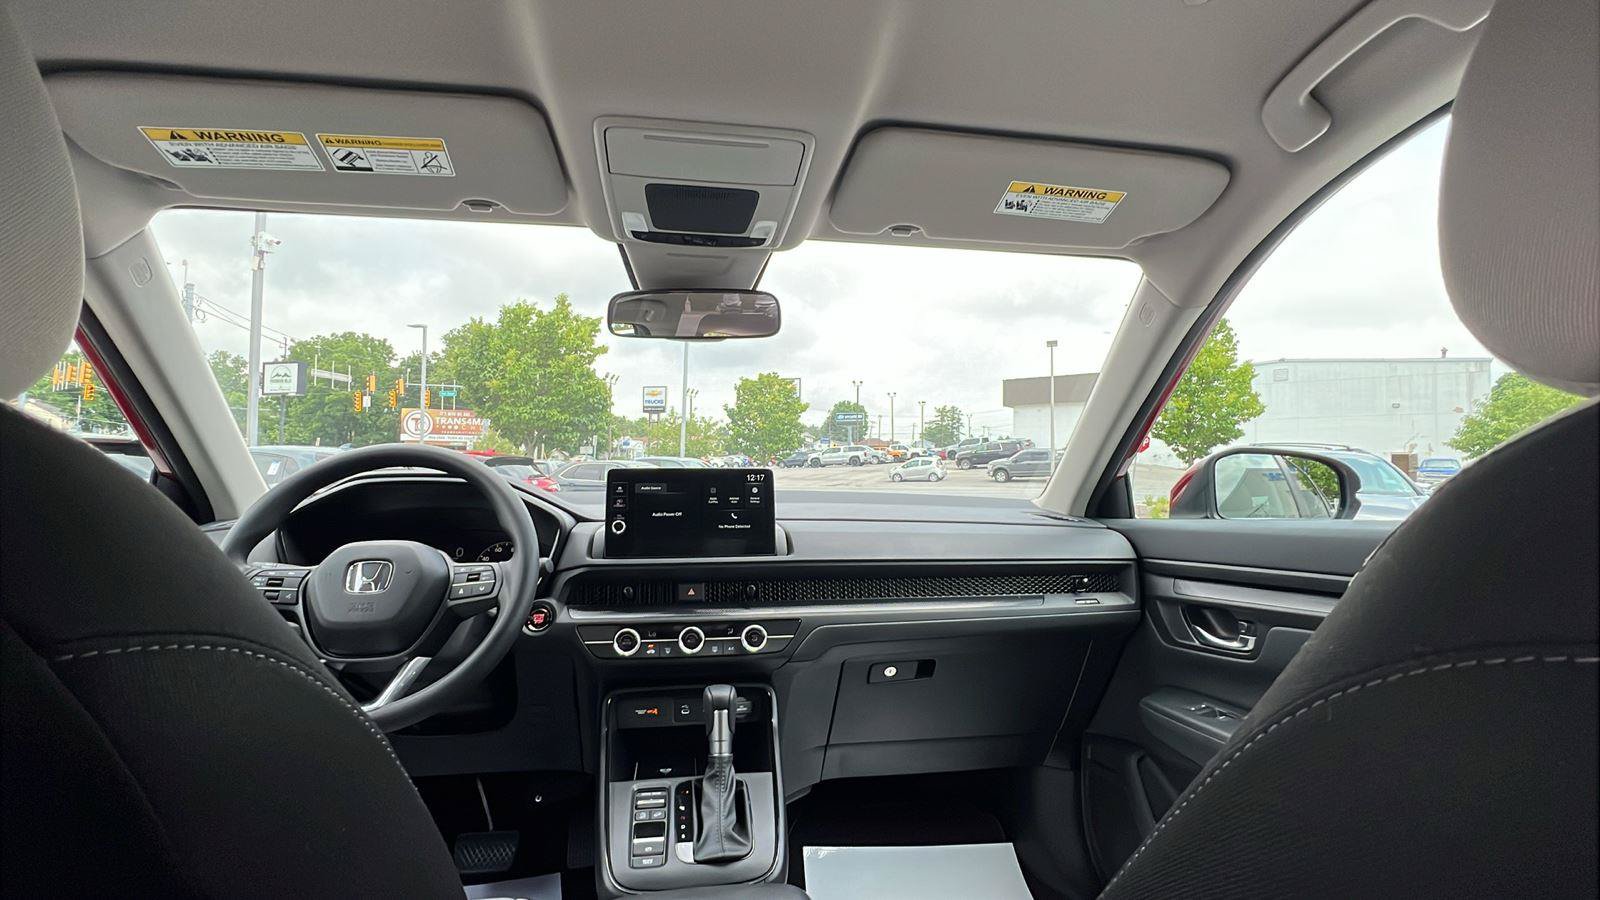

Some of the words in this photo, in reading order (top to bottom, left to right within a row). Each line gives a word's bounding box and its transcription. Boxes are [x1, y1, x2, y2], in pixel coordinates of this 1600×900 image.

[193, 130, 285, 142] WARNING
[335, 137, 382, 146] WARNING
[1044, 187, 1107, 199] WARNING
[746, 474, 765, 482] 12:17
